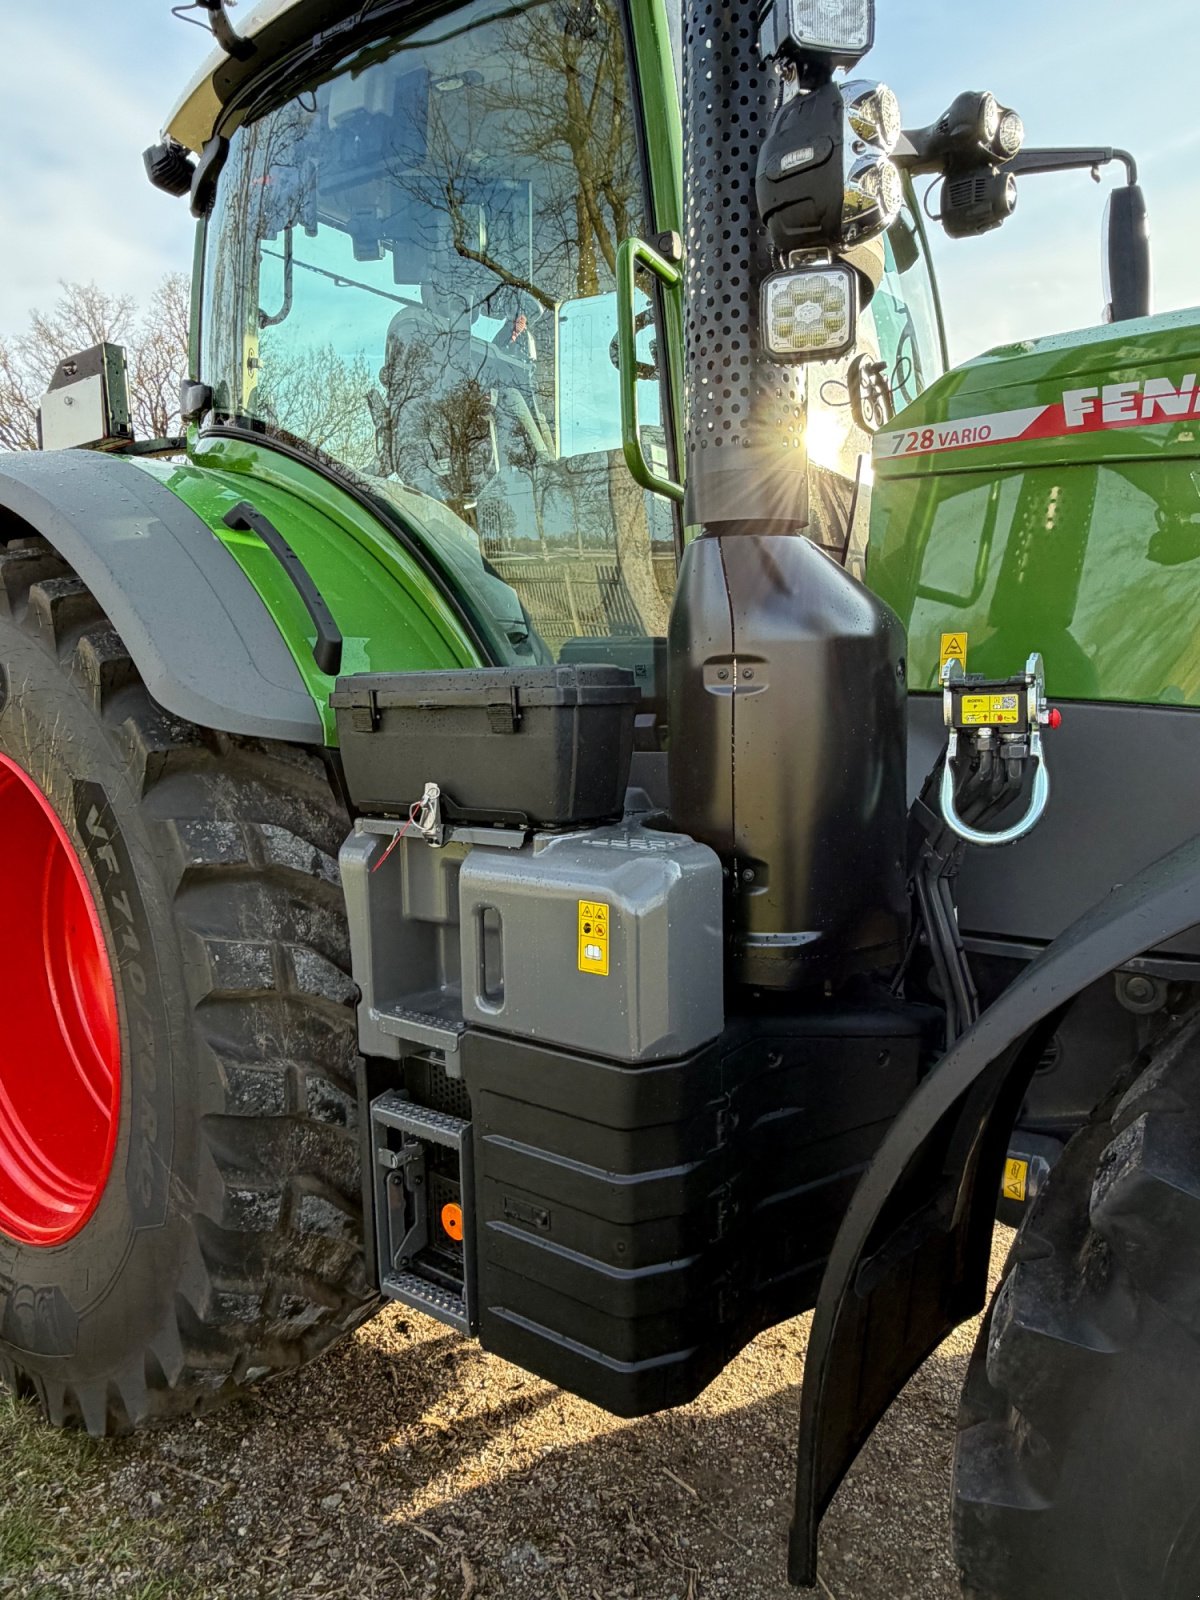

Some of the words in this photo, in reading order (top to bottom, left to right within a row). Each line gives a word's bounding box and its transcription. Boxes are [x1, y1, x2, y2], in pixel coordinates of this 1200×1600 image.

[1062, 373, 1200, 428] FEN
[891, 428, 935, 455] 728
[937, 424, 992, 447] VARIO
[85, 803, 120, 874] VF
